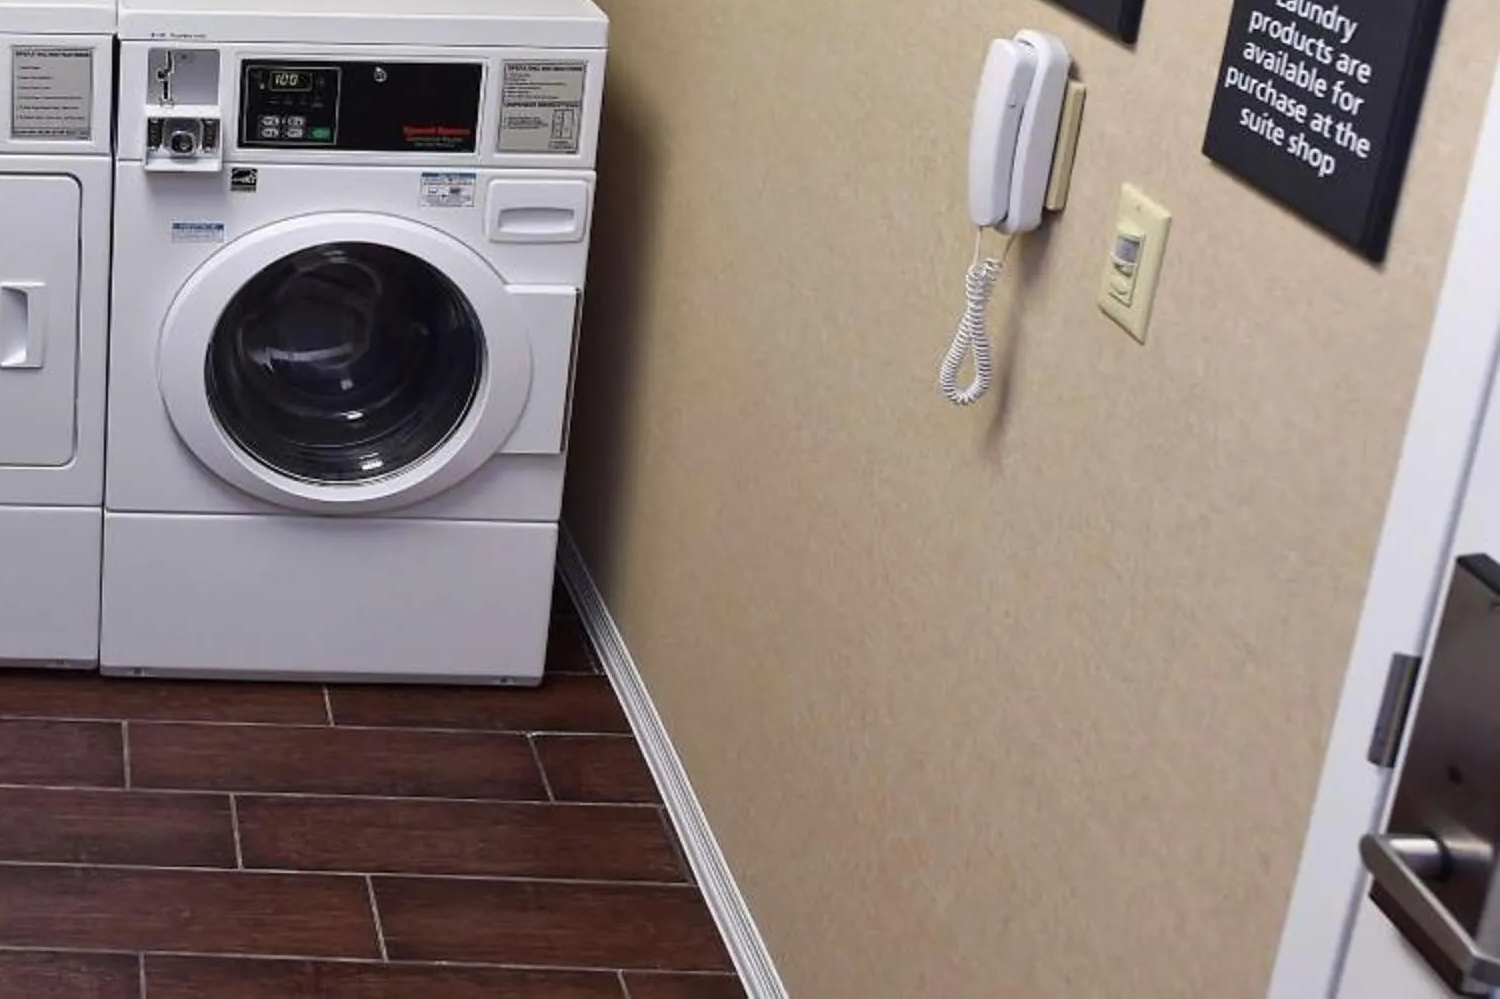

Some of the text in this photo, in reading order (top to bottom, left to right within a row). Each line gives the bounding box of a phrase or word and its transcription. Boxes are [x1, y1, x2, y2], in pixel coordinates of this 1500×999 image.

[1243, 40, 1364, 116] available for
[1248, 9, 1372, 84] products are
[1224, 65, 1371, 158] purchase at the
[1239, 106, 1336, 178] suite shop
